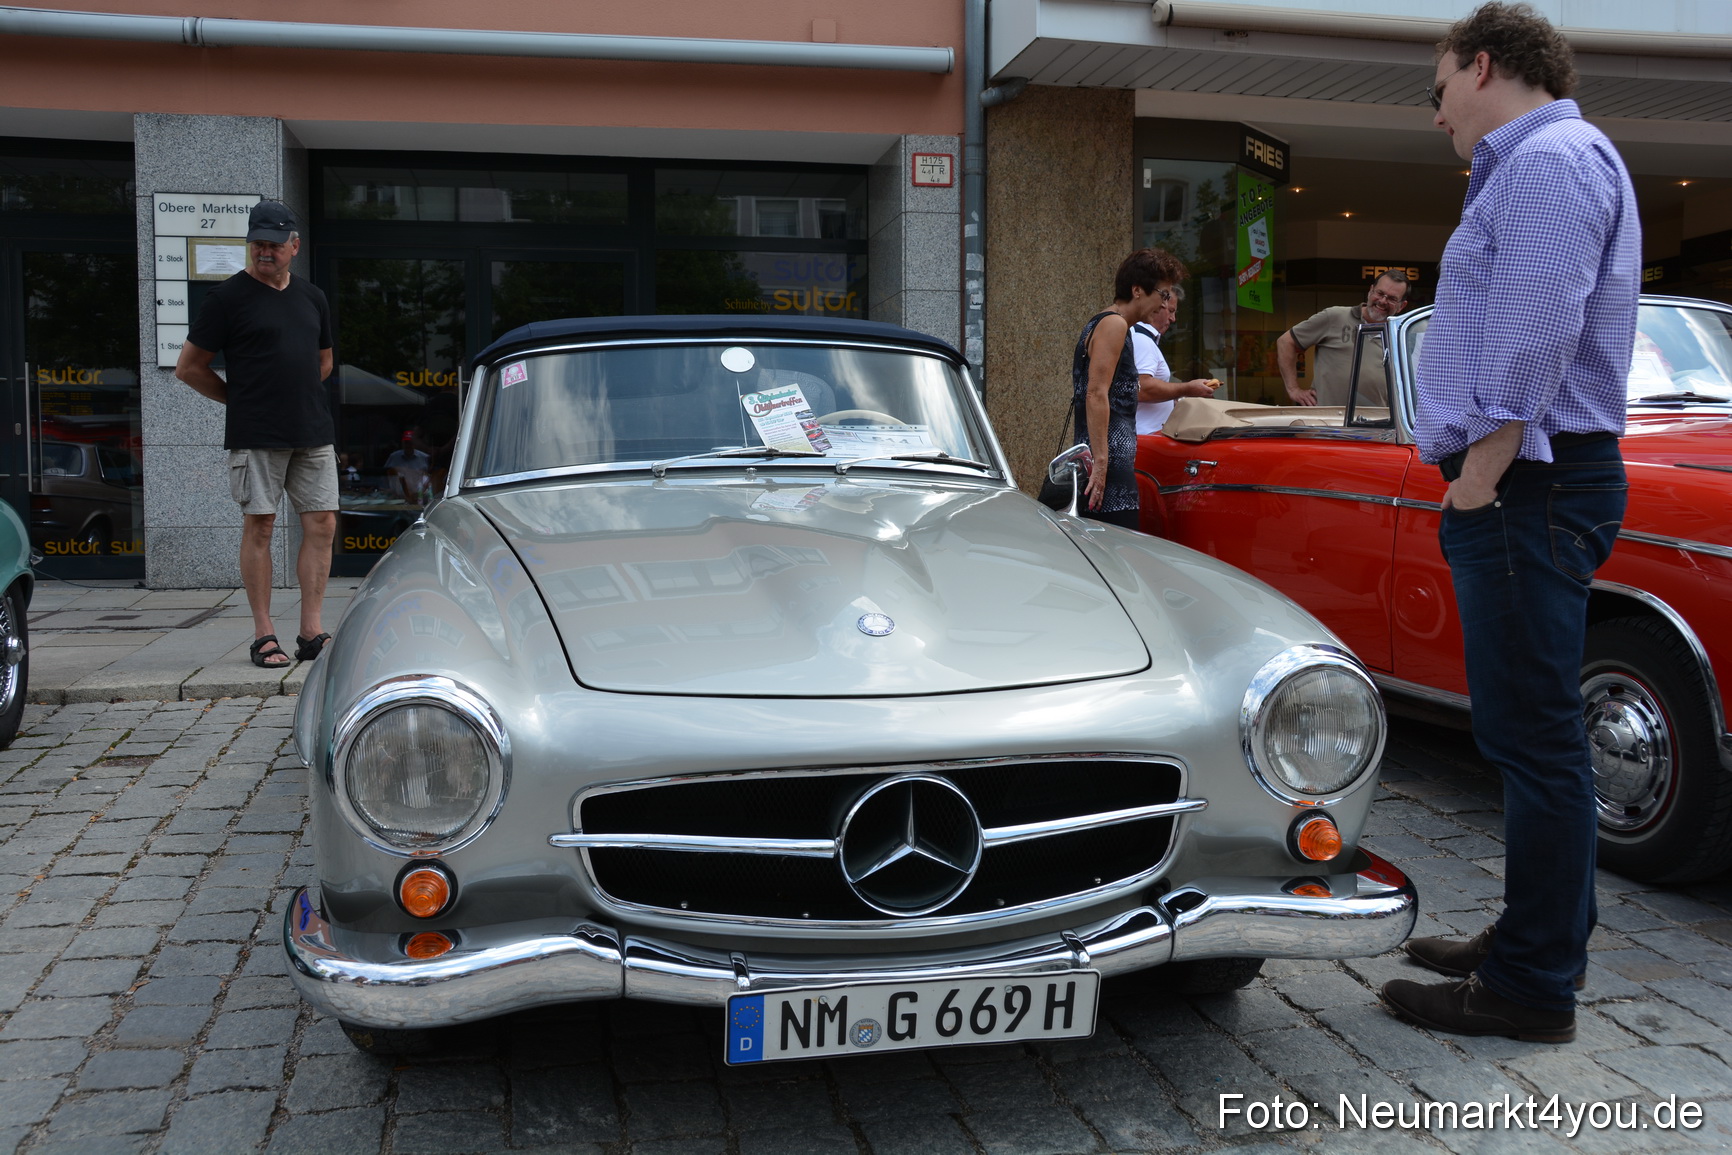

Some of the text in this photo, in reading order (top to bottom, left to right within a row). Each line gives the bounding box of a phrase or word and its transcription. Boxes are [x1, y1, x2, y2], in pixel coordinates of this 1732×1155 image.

[1245, 135, 1284, 170] FRIES
[158, 202, 196, 213] Obere
[1240, 196, 1273, 226] ANGEBOTE
[200, 218, 217, 229] 27
[166, 254, 184, 262] Stock
[1361, 265, 1420, 281] FRS
[724, 297, 759, 310] Schuhe
[760, 298, 772, 313] by
[780, 994, 848, 1051] NM
[886, 991, 918, 1042] G
[740, 1036, 753, 1052] D
